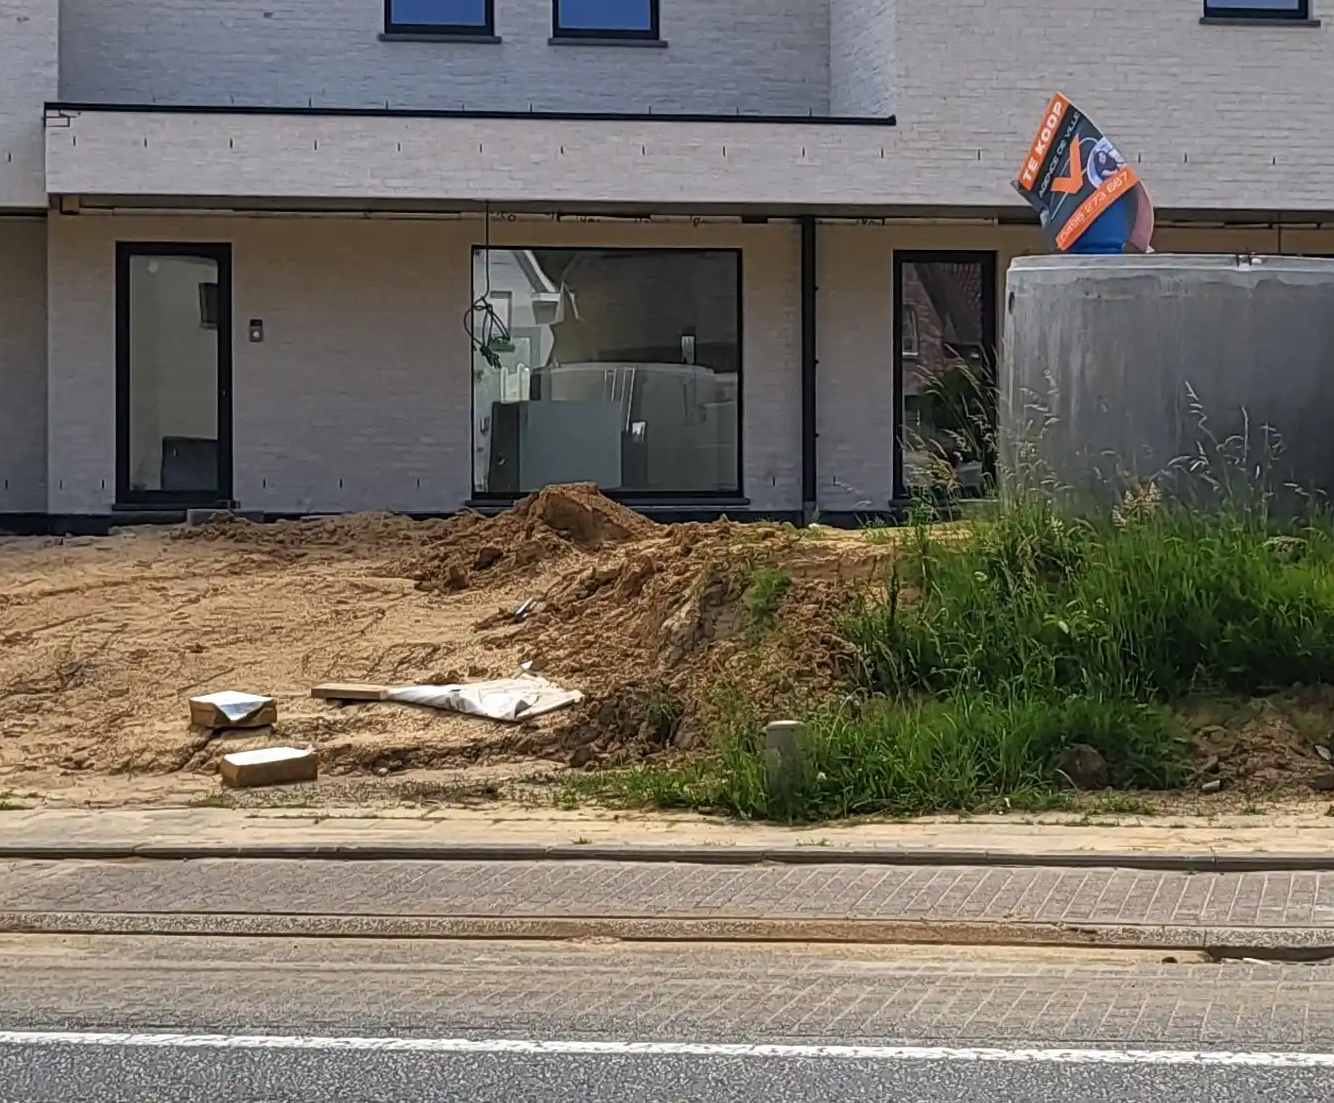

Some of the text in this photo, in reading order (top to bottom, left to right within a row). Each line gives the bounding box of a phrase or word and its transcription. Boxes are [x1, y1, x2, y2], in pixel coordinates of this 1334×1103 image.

[1022, 100, 1063, 182] TE KOOP
[1038, 111, 1081, 199] AGENCE DE VILLE
[1084, 190, 1107, 213] 273
